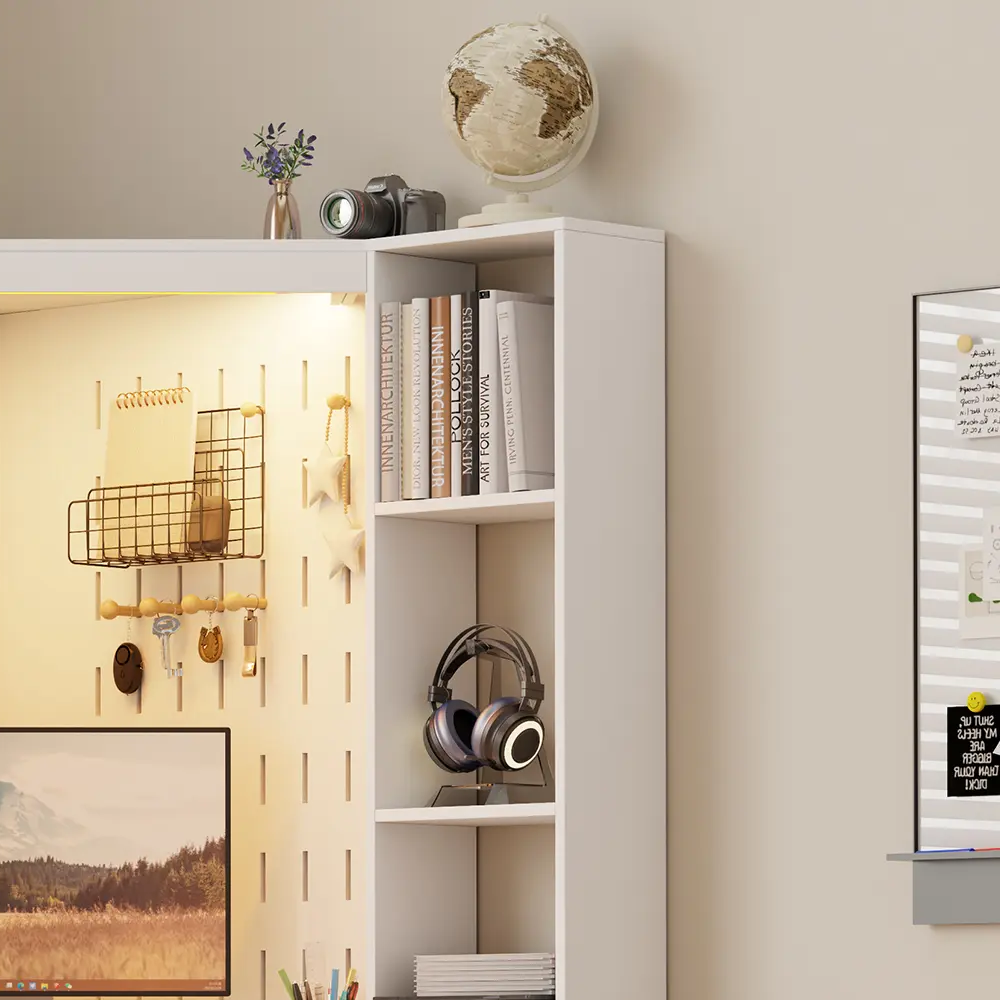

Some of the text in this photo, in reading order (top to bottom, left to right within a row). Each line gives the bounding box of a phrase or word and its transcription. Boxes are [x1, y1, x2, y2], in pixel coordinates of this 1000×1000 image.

[413, 308, 421, 387] REVOLUTION
[462, 307, 473, 475] MEN'S STYLE STORIES
[501, 334, 512, 395] CENTENNIAL
[381, 312, 394, 473] INNENARCHITEKTUR
[413, 390, 421, 423] LOOK
[432, 325, 444, 488] INNENARCHITEKTUR
[451, 349, 461, 444] POLLOCK
[480, 374, 490, 483] ART FOR SURVIVAL
[413, 426, 421, 454] NEW
[507, 428, 517, 465] IRVING
